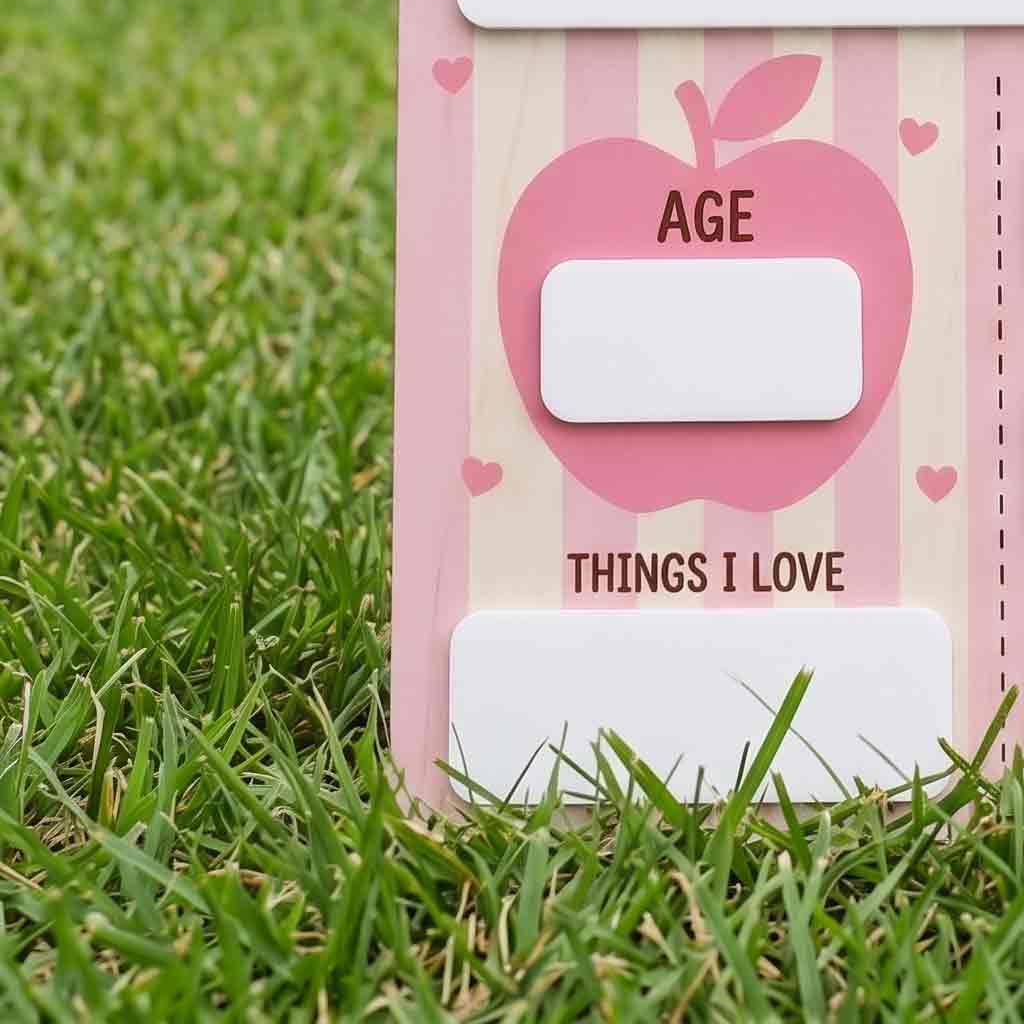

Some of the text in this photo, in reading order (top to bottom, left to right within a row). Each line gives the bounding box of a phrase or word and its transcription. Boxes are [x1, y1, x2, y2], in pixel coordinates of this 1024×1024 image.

[655, 188, 755, 244] AGE
[565, 550, 846, 594] THINGS I LOVE
